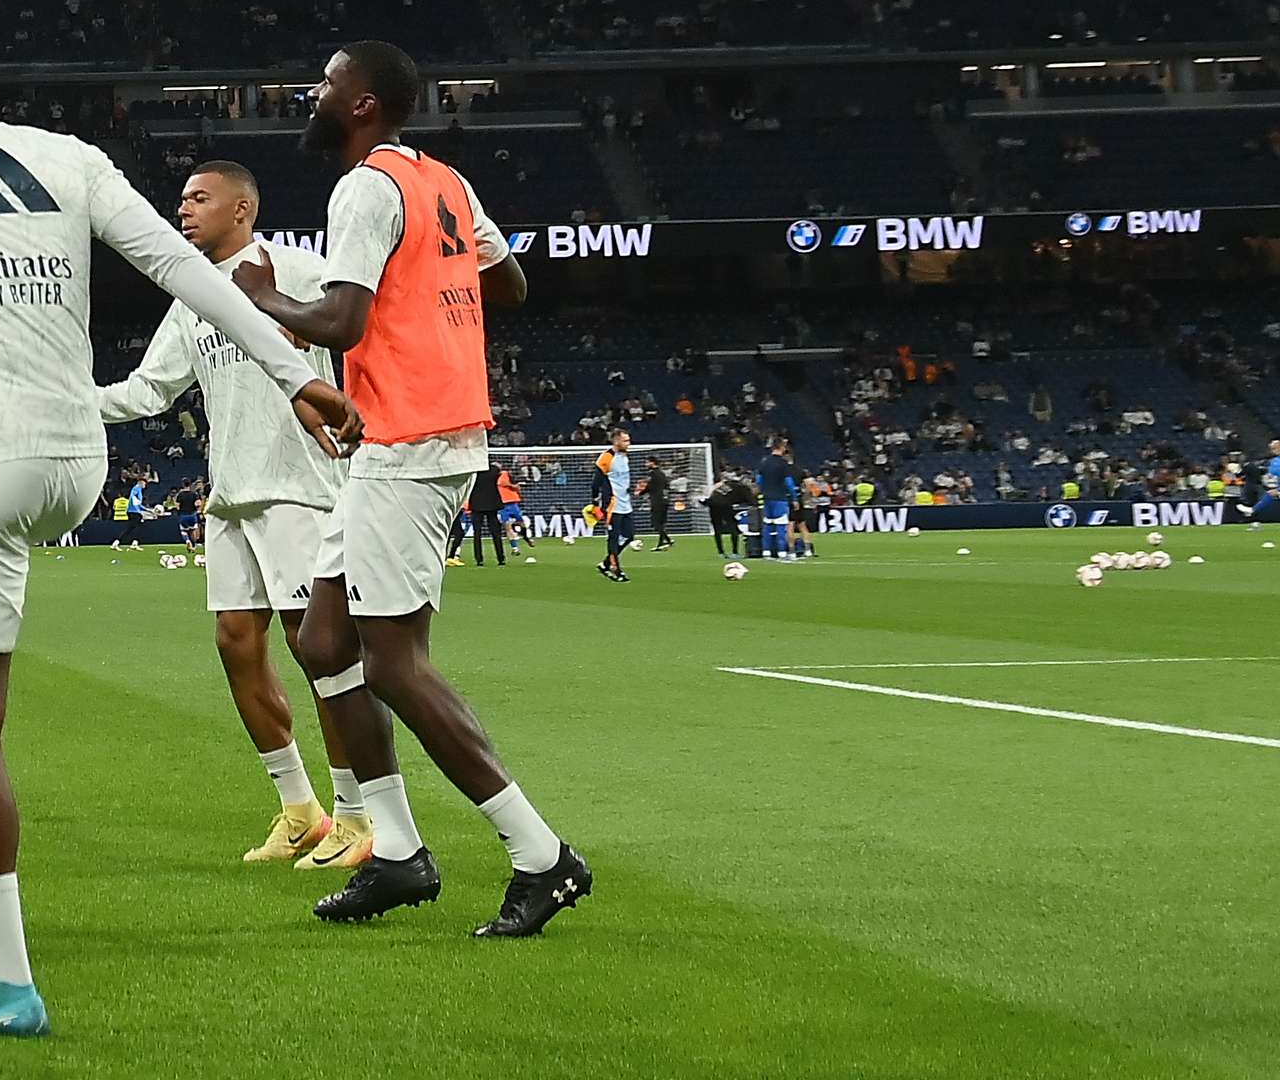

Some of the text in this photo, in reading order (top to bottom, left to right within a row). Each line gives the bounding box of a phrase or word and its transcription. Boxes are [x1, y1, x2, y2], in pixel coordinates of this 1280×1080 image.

[876, 216, 984, 251] BMW
[1127, 210, 1201, 234] BMW
[253, 231, 324, 253] MW
[548, 224, 652, 258] BMW
[11, 282, 63, 306] BETTER
[1131, 501, 1224, 527] BMW
